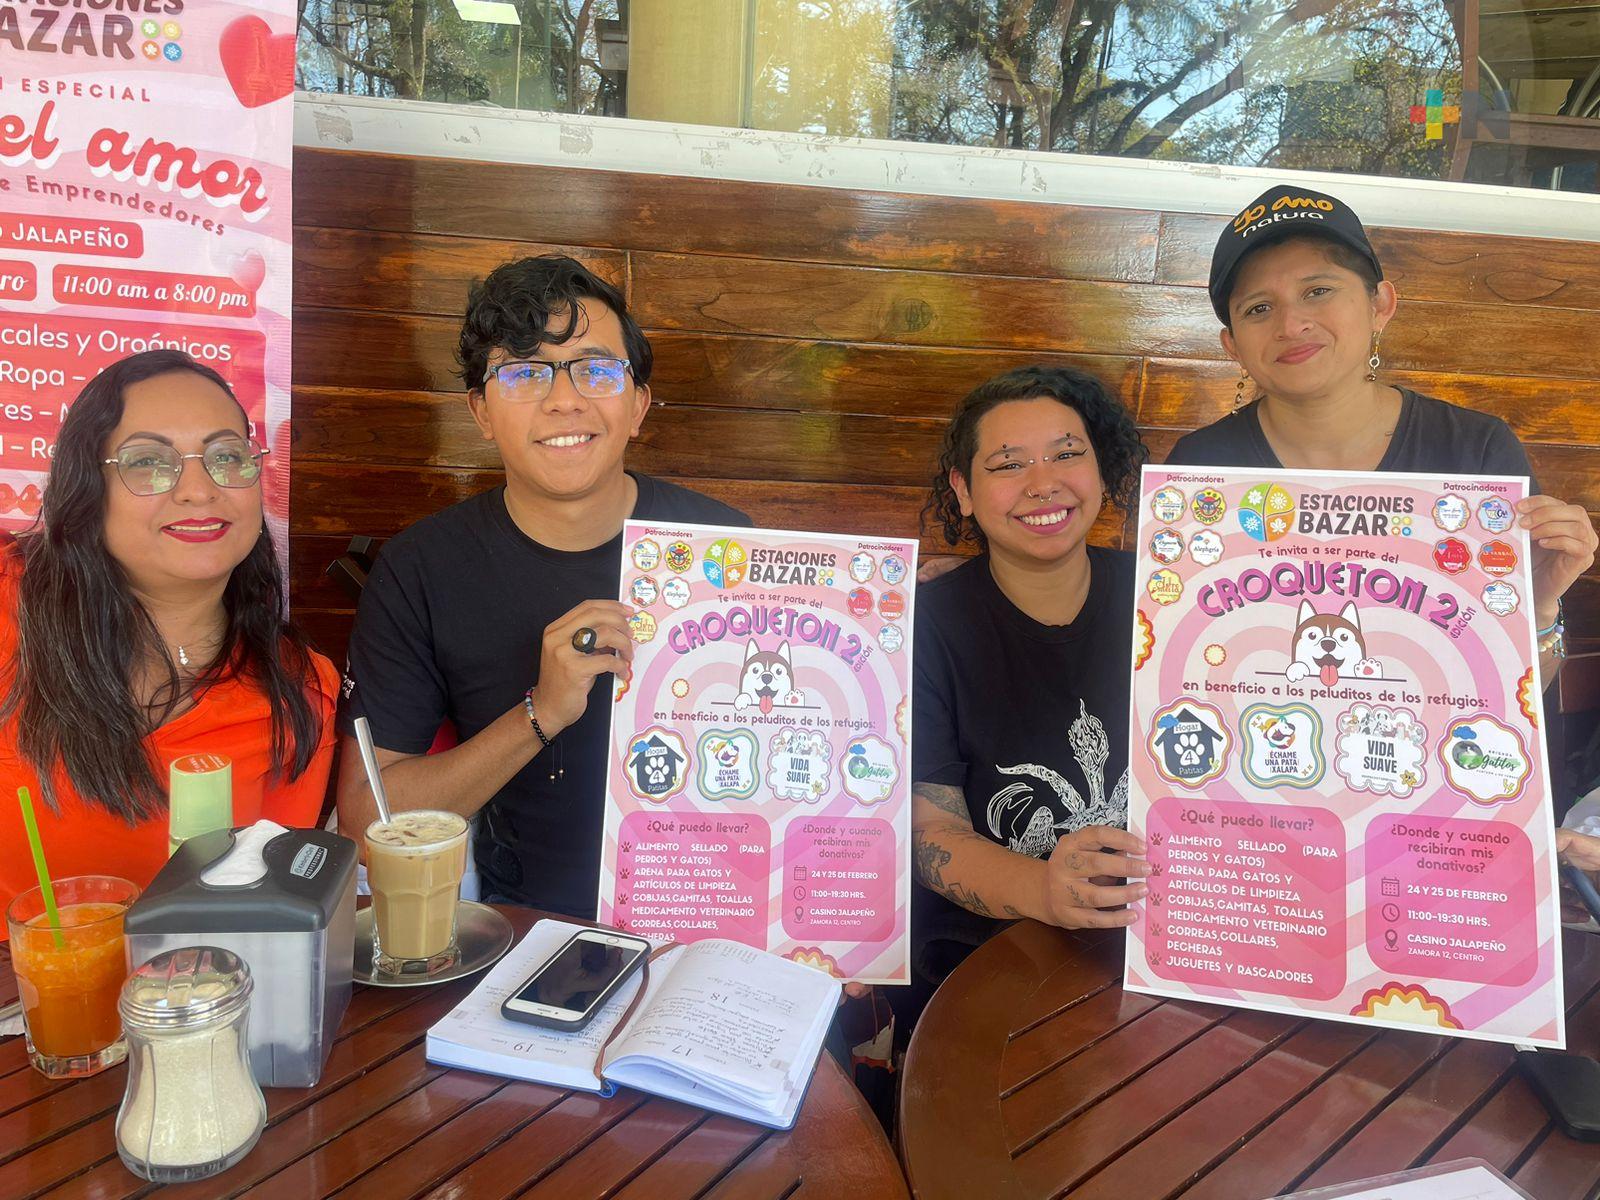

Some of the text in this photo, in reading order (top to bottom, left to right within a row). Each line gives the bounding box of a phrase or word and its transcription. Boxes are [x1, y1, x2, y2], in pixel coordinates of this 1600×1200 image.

[22, 78, 151, 102] ESPECIAL
[86, 127, 268, 213] amor
[26, 174, 225, 236] Emprendedores
[1233, 195, 1335, 234] yo amo
[1242, 210, 1324, 238] natura
[12, 222, 129, 249] JALAPEÑO
[63, 274, 249, 309] 11:00 am a 8:00 pm
[1, 323, 69, 350] cales
[77, 334, 92, 356] y
[0, 360, 65, 391] Ropa
[1166, 474, 1225, 484] Patrocinadores
[1443, 482, 1507, 492] Patrocinadores
[1299, 493, 1415, 513] ESTACIONES
[1298, 511, 1389, 536] BAZAR
[645, 528, 693, 539] Patrocinadores
[858, 542, 904, 553] Patrocinadores
[1258, 544, 1400, 564] Te invita a ser parte del
[750, 548, 837, 567] ESTACIONES
[748, 563, 817, 586] BAZAR
[717, 592, 823, 610] Te invita ser parte del
[1197, 560, 1428, 617] CROQUETON
[1429, 592, 1459, 630] 2
[667, 604, 843, 655] CROQUETON
[840, 633, 862, 666] 2
[1183, 679, 1489, 710] en beneficio a los peluditos de los refugios:
[653, 710, 876, 731] en beneficio a los peluditos de los refugios:
[1175, 723, 1199, 733] Hogar
[1269, 748, 1297, 759] ÉCHAME
[1367, 739, 1395, 758] VIDA
[790, 757, 809, 772] VIDA
[1184, 751, 1194, 764] 4
[1264, 758, 1298, 767] UNA PATA
[1363, 756, 1398, 774] SUAVE
[786, 770, 811, 785] SUAVE
[1271, 766, 1299, 774] XALAPA
[647, 820, 750, 834] ¿Qué puedo llevar?
[1180, 809, 1314, 831] ¿Qué puedo llevar?
[803, 824, 882, 836] ¿Donde y cuando
[1391, 824, 1510, 845] ¿Donde y cuando
[635, 842, 765, 854] ALIMENTO SELLADO (PARA
[813, 837, 852, 847] recibiran
[1168, 835, 1338, 858] ALIMENTO SELLADO (PARA
[819, 849, 864, 859] donativos?
[1168, 849, 1265, 869] PERROS Y GATOS)
[1408, 843, 1494, 859] recibiran mis
[635, 855, 712, 866] PERROS Y GATOS)
[1417, 857, 1485, 874] donativos?
[634, 868, 732, 877] ARENA PARA GATOS Y
[811, 870, 820, 878] 24
[837, 871, 847, 879] DE
[847, 871, 878, 880] FEBRERO
[1168, 865, 1293, 885] ARENA PARA GATOS Y
[633, 879, 737, 891] ARTÍCULOS DE LIMPIEZA
[1168, 879, 1301, 902] ARTÍCULOS DE LIMPIEZA
[1407, 884, 1508, 903] 24 Y 25 DE FEBRERO
[716, 894, 753, 904] TOALLAS
[850, 891, 866, 899] HRS.
[631, 906, 755, 917] MEDICAMENTO VETERINARIO
[810, 907, 875, 917] CASINO JALAPEÑO
[1274, 905, 1324, 920] TOALLAS
[1168, 909, 1327, 937] MEDICAMENTO VETERINARIO
[1466, 915, 1491, 927] HRS.
[1167, 940, 1223, 957] PECHERAS
[1407, 933, 1506, 952] CASINO JALAPEÑO
[1408, 947, 1441, 958] ZAMORA
[1453, 952, 1485, 962] CENTRO
[1166, 956, 1314, 984] JUGUETES Y RASCADORES
[511, 1040, 536, 1054] 19
[671, 1044, 694, 1057] 17
